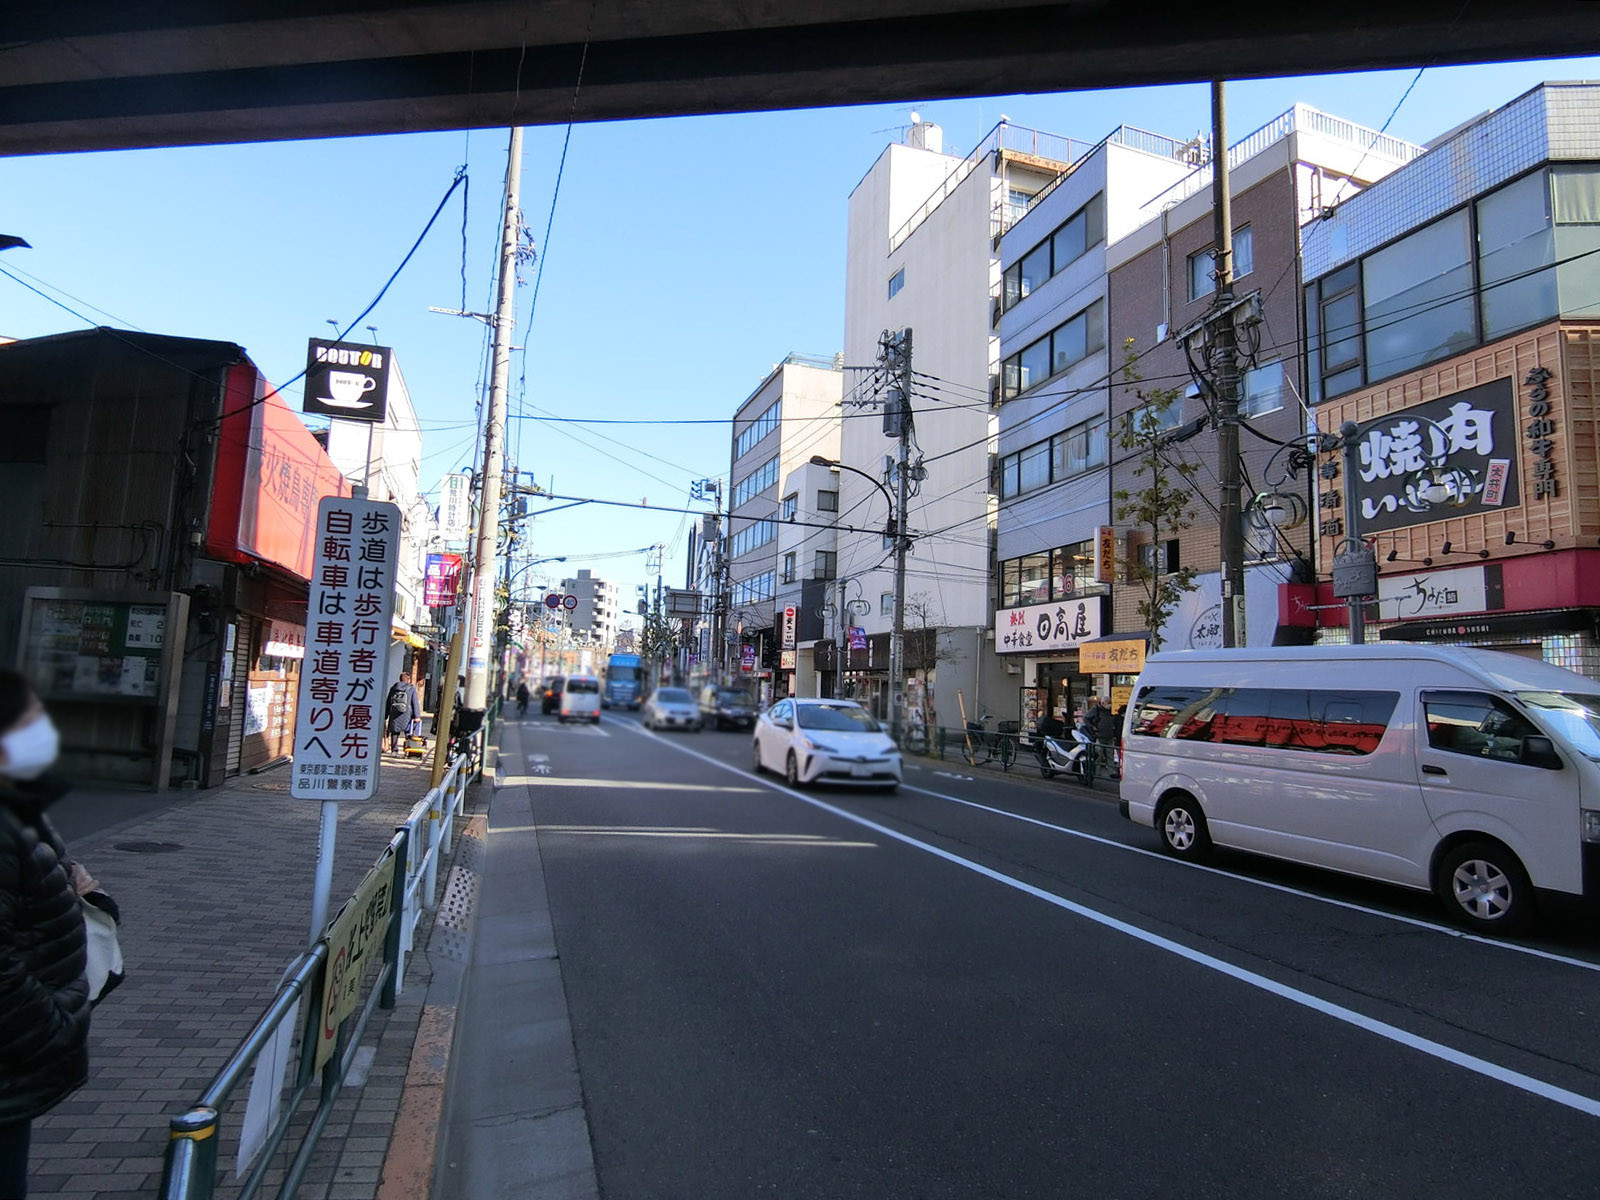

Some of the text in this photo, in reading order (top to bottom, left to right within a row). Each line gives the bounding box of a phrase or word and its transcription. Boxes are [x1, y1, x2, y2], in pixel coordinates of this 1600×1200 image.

[316, 346, 382, 369] DOUTOR
[1359, 402, 1496, 482] 焼肉
[1486, 466, 1503, 500] 大井町
[304, 509, 352, 759] 自転車は車道寄りへ
[340, 511, 389, 760] 歩道は歩行者が優先
[1003, 629, 1033, 648] 中華食堂
[1037, 602, 1091, 641] 日高屋
[1109, 648, 1138, 661] 友だち
[298, 778, 367, 790] 品川警察署
